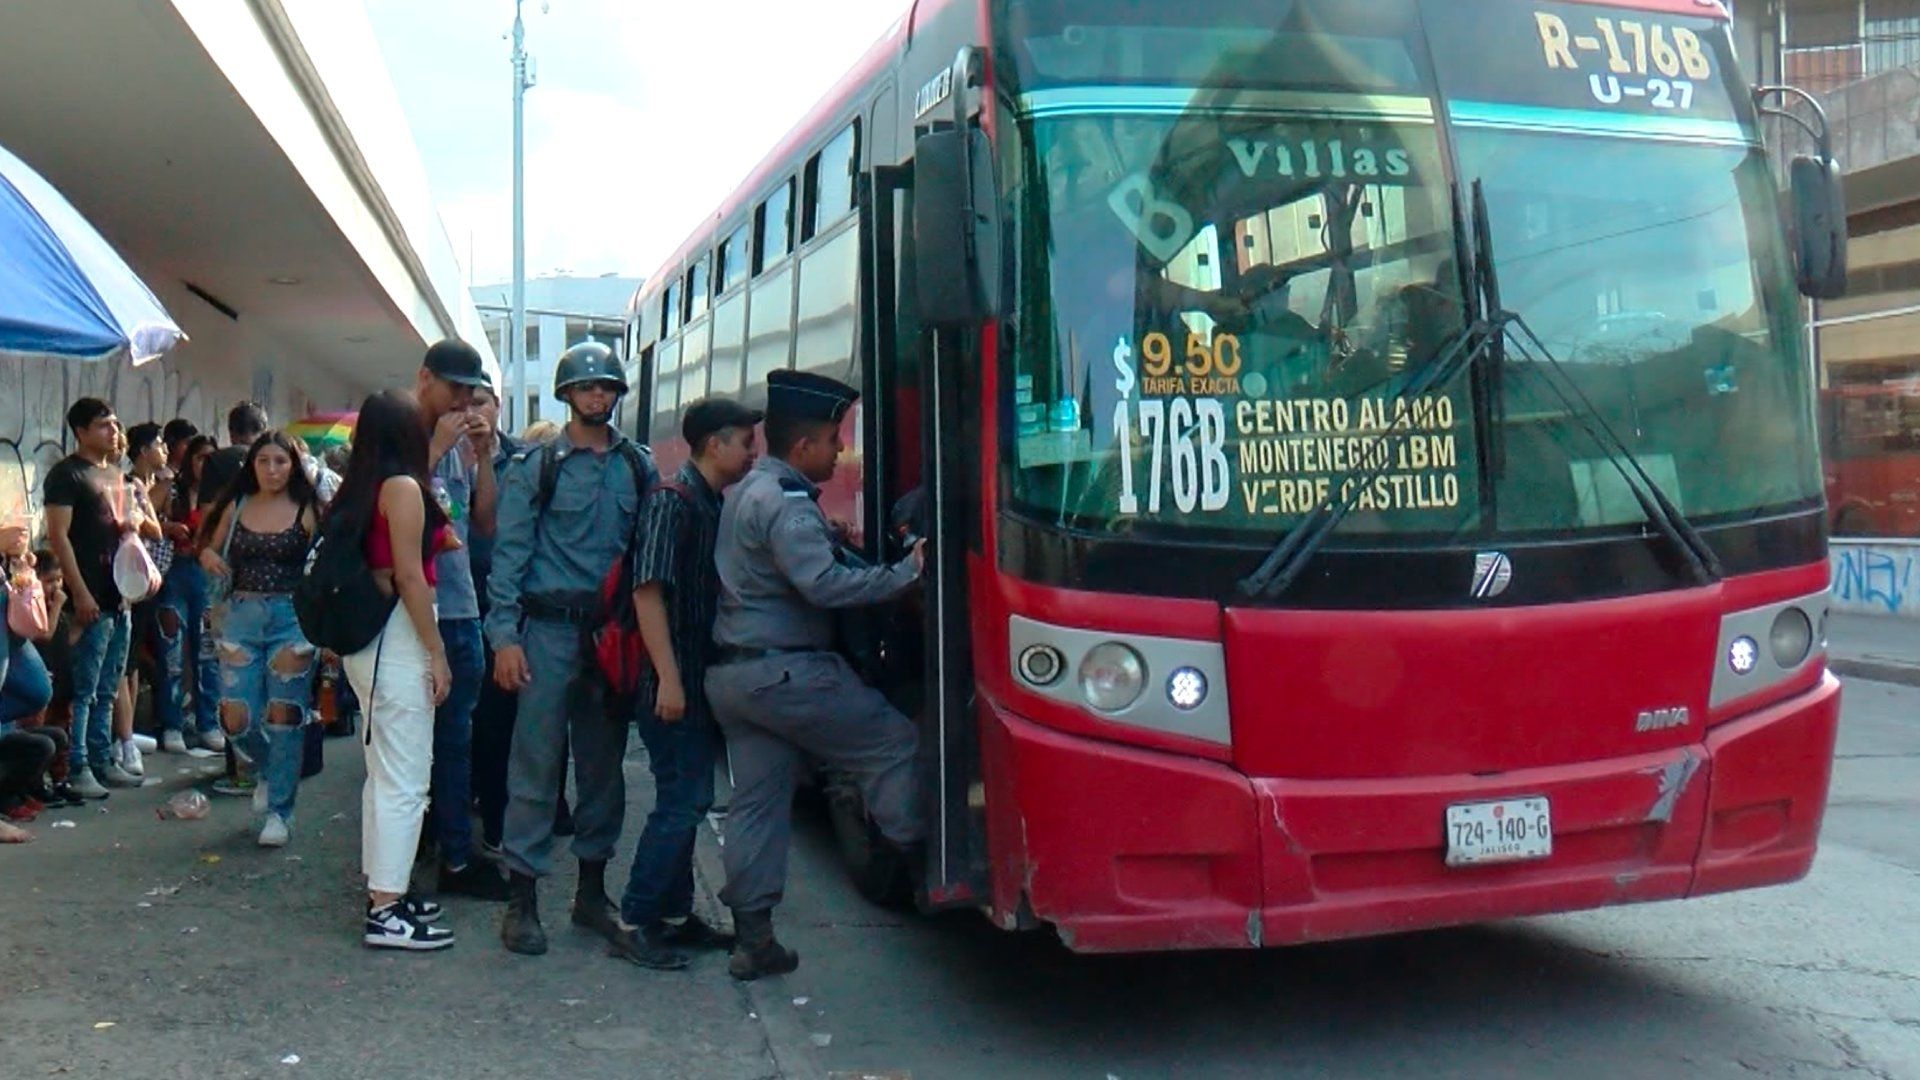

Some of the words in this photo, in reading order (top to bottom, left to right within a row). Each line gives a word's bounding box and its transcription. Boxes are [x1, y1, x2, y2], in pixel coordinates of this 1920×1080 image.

[1534, 11, 1710, 80] R-176B
[1588, 73, 1694, 110] U-27
[1226, 139, 1410, 178] Villas
[1142, 377, 1187, 395] TARIFA
[1190, 377, 1240, 395] EXACTA
[1236, 397, 1349, 434] CENTRO
[1358, 395, 1453, 430] ALAMO
[1113, 396, 1230, 514] 176B
[1239, 436, 1390, 473] MONTENEGRO
[1241, 478, 1334, 513] VERDE
[1341, 472, 1459, 511] CASTILLO
[1636, 706, 1689, 732] DINA
[1452, 814, 1549, 847] 724-140-G
[1479, 843, 1521, 855] JALISCO
